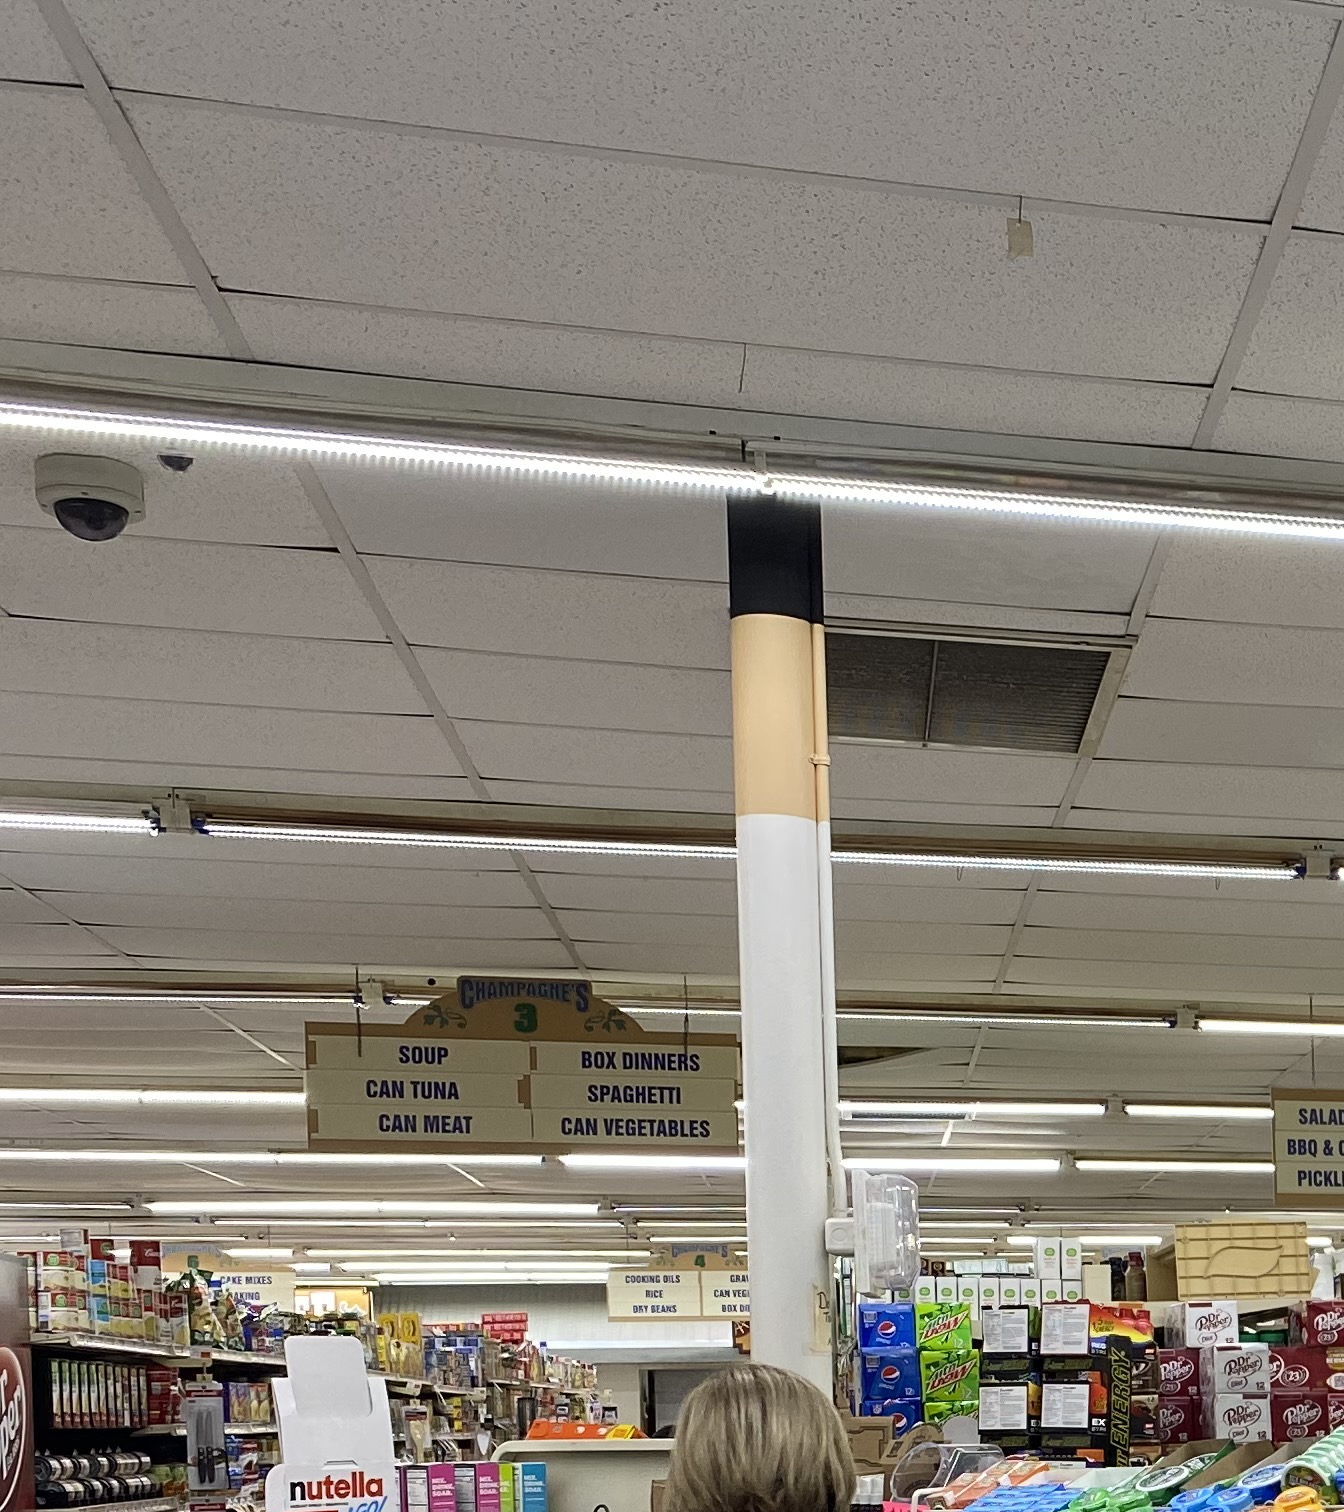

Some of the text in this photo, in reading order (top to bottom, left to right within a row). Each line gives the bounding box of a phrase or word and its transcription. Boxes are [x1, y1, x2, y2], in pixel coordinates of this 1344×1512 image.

[459, 978, 590, 1012] CHAMPAGNE'S
[513, 1003, 538, 1032] 3
[399, 1046, 448, 1065] SOUP
[581, 1051, 700, 1072] BOX DINNERS
[366, 1080, 459, 1100] CAN TUNA
[588, 1085, 681, 1104] SPAGHETTI
[378, 1114, 472, 1134] CAN MEAT
[561, 1118, 710, 1138] CAN VEGETABLES
[1287, 1139, 1318, 1157] BBQ
[1323, 1140, 1334, 1156] &
[220, 1276, 272, 1286] CAKE MIXES
[625, 1275, 681, 1284] COOKING OILS
[645, 1290, 663, 1298] RICE
[713, 1290, 730, 1298] CAN
[633, 1305, 677, 1313] DRY BEANS
[721, 1304, 737, 1313] BOX
[1160, 1363, 1192, 1381] Pepper
[1169, 1359, 1183, 1370] Dr
[1289, 1370, 1299, 1381] 23
[1255, 1382, 1265, 1390] 12
[1110, 1348, 1131, 1450] ENERGY
[1223, 1408, 1260, 1425] Pepper
[1236, 1405, 1250, 1415] Dr
[1284, 1408, 1319, 1425] Pepper
[1297, 1404, 1310, 1415] Dr
[1257, 1431, 1267, 1439] 12
[290, 1471, 383, 1501] nutella
